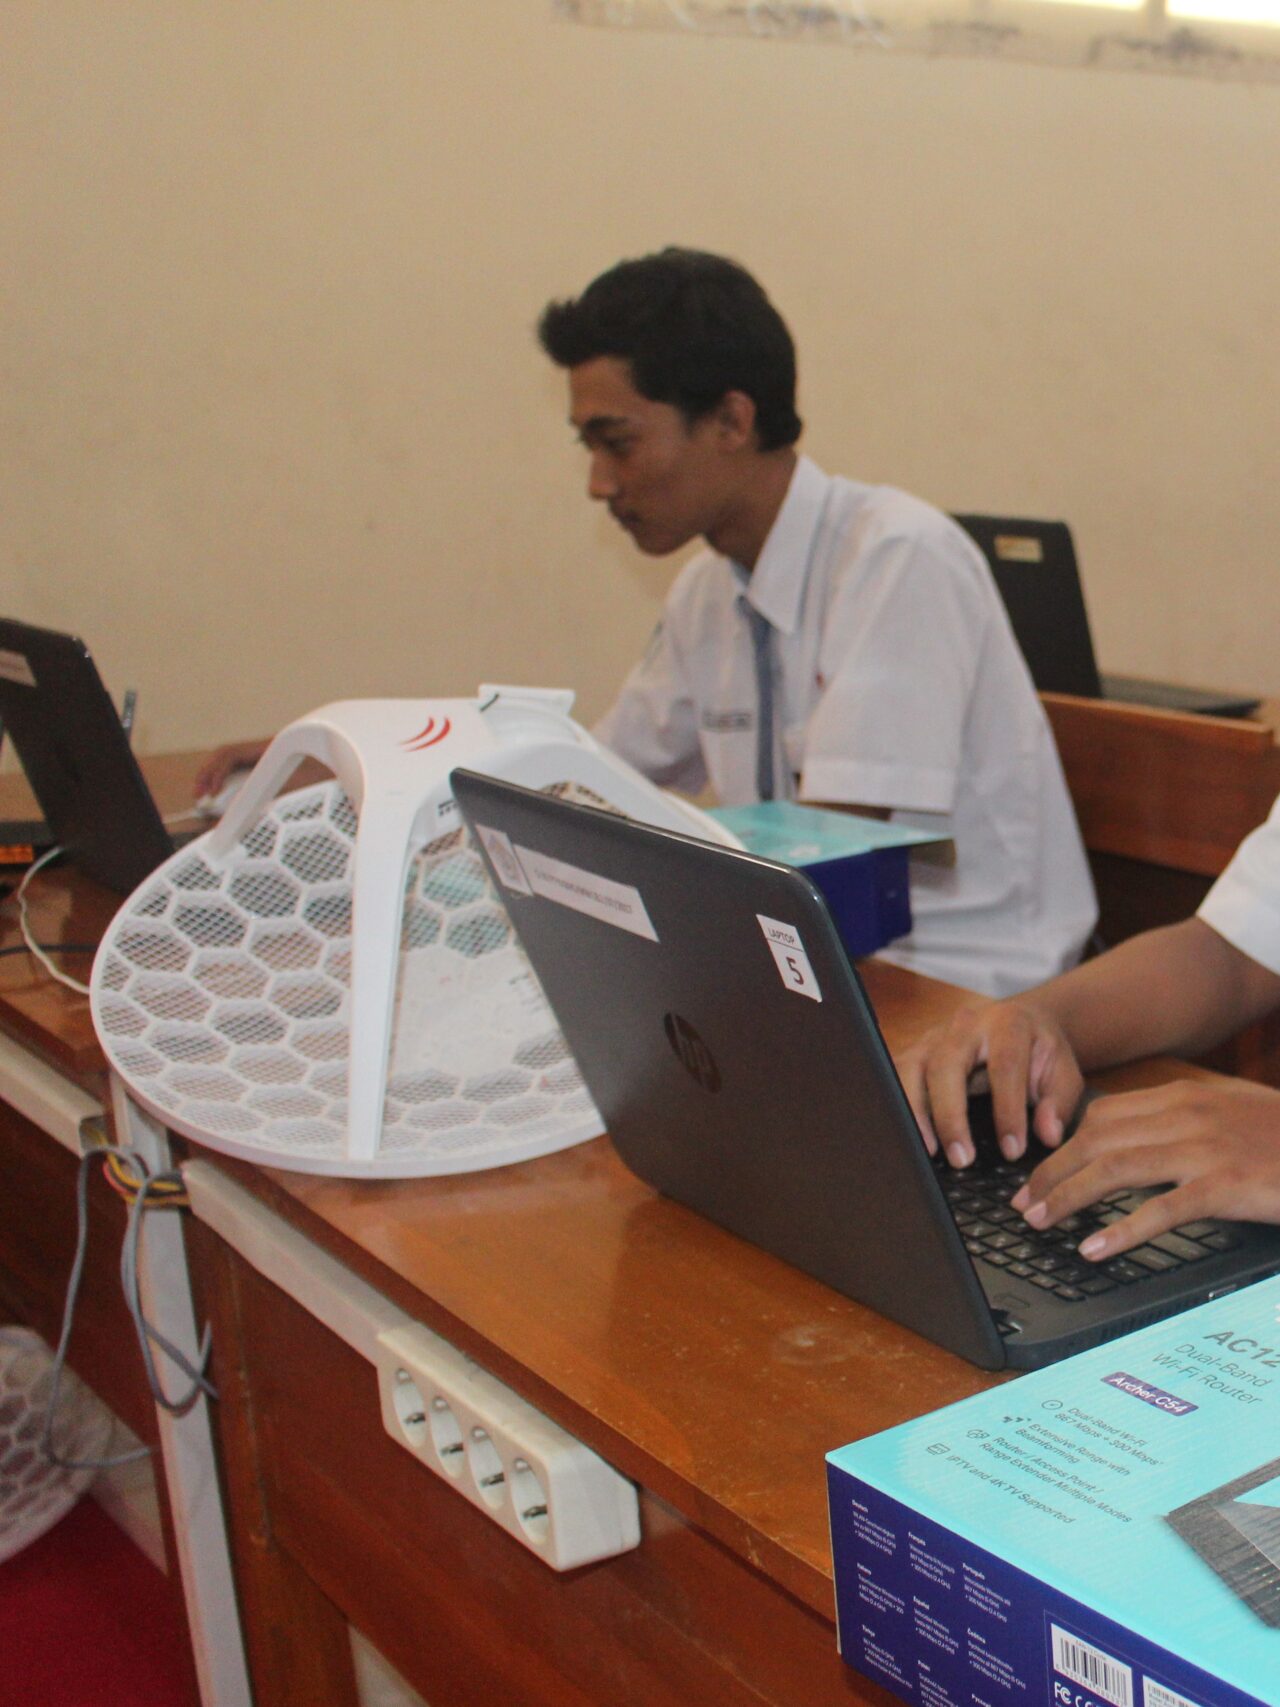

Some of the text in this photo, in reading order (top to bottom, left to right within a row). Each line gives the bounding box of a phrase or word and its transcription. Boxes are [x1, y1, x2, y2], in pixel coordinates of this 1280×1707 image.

[768, 927, 794, 944] LAPTOP
[786, 956, 804, 985] 5
[1152, 1353, 1263, 1404] Wi-Fi Router
[1175, 1344, 1273, 1387] Dual-Band
[1110, 1377, 1187, 1413] Archer C54
[1016, 1428, 1080, 1464] Beamforming
[1029, 1423, 1131, 1476] Extensive Range with
[1075, 1423, 1102, 1438] Mbps
[979, 1443, 1132, 1523] Range Extender Multiple Modes
[993, 1437, 1027, 1455] Router
[1031, 1457, 1067, 1478] Access
[1067, 1475, 1097, 1491] Point
[946, 1455, 1077, 1524] IPTV and 4K TV Supported
